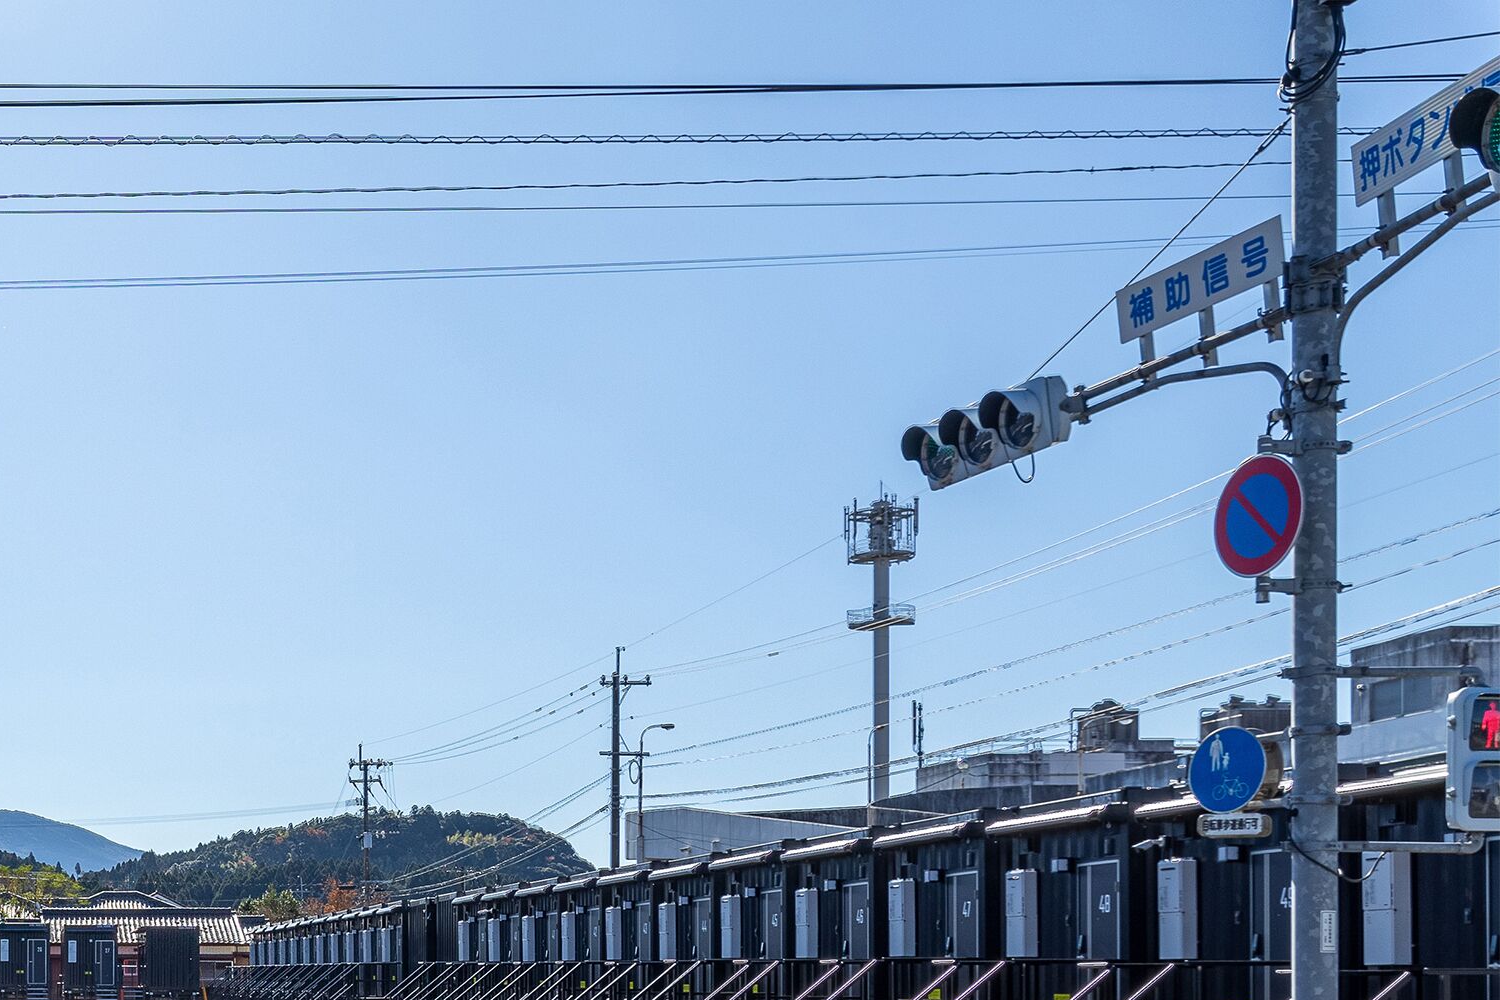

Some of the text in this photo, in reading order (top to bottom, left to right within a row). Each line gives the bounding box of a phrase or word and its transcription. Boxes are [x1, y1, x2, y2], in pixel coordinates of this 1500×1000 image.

[1129, 235, 1269, 329] 補助信号
[962, 900, 971, 918] 47
[1098, 894, 1111, 913] 48
